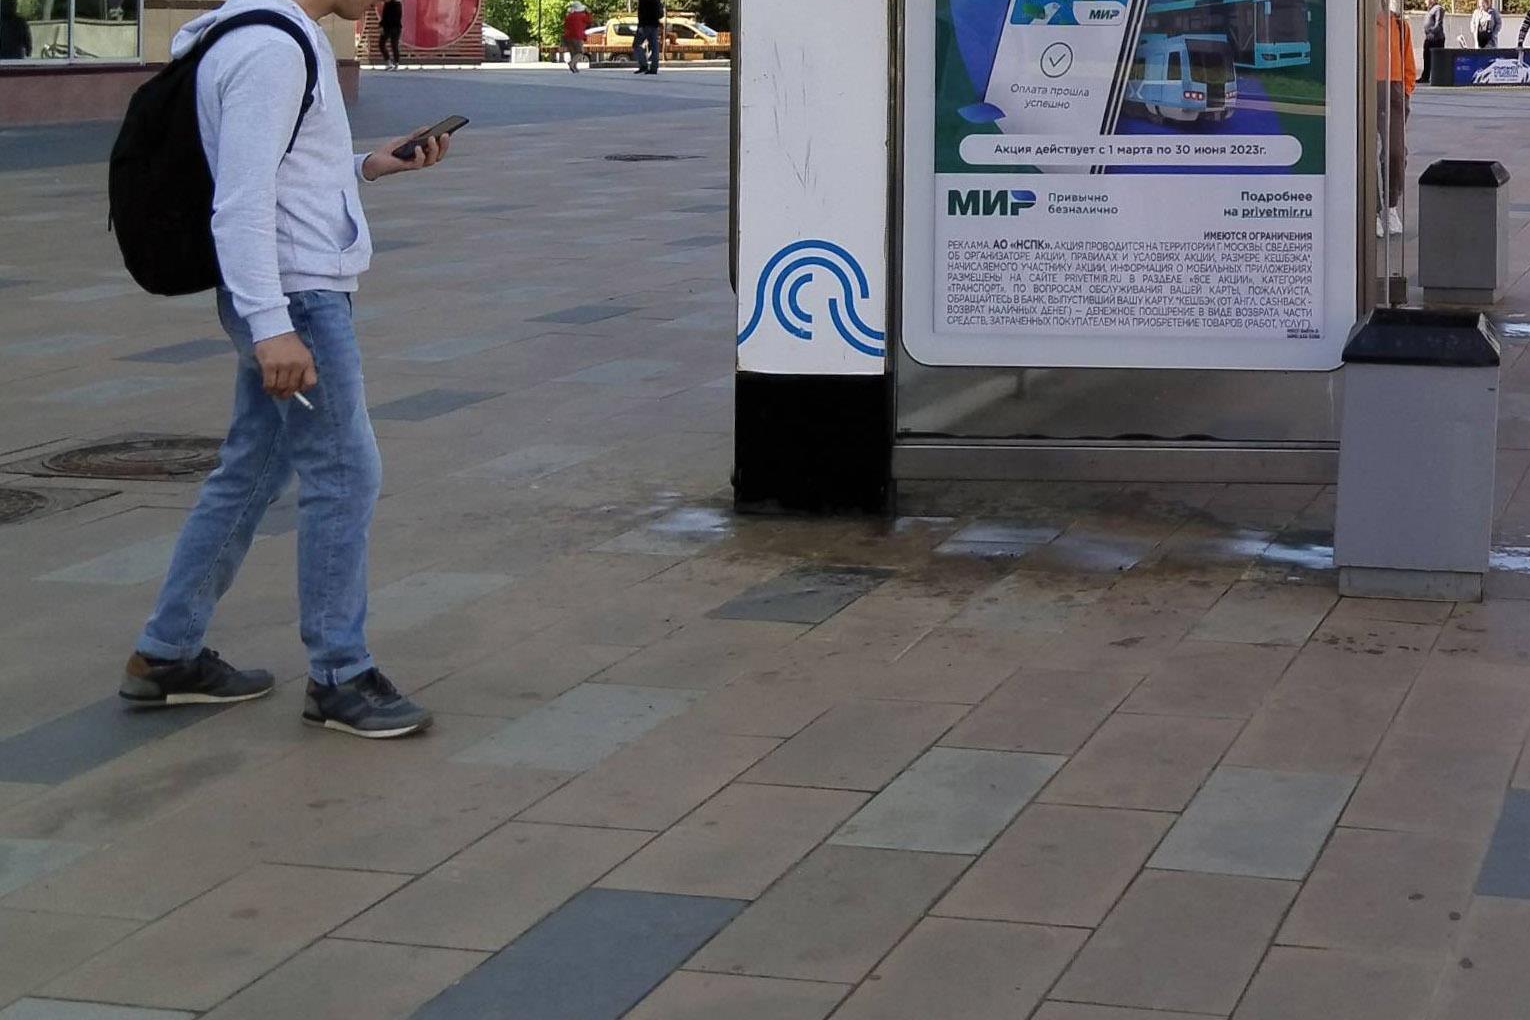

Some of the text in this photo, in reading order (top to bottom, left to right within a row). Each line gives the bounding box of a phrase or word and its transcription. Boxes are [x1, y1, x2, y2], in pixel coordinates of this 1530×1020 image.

[1088, 9, 1120, 20] МИР
[1010, 83, 1090, 98] Оплата прошла
[1024, 99, 1070, 109] успешно
[994, 144, 1032, 155] Акция
[1035, 143, 1095, 155] действует
[1098, 146, 1105, 155] с
[1117, 146, 1153, 156] марта
[1157, 146, 1172, 155] по
[1175, 144, 1191, 155] 30
[1194, 146, 1226, 155] июня
[1230, 144, 1267, 155] 2023г.
[947, 189, 1037, 216] МИР
[1048, 192, 1109, 204] Привычно
[1241, 191, 1312, 203] Подробнее
[1048, 203, 1118, 215] безналично
[1224, 206, 1312, 218] на privetmir.ru
[1203, 232, 1313, 241] ИМЕЮТСЯ ОГРАНИЧЕНИЯ
[993, 240, 1008, 250] АО
[1265, 241, 1313, 251] СВЕДЕНИЯ
[1010, 272, 1021, 282] НА
[1029, 273, 1057, 282] САЙТЕ
[1143, 273, 1182, 283] РАЗДЕЛЕ
[1013, 283, 1027, 293] ПО
[1033, 284, 1082, 293] ВОПРОСАМ
[1170, 284, 1202, 294] ВАШЕЙ
[947, 305, 985, 314] ВОЗВРАТ
[1283, 307, 1312, 316] ЧАСТИ
